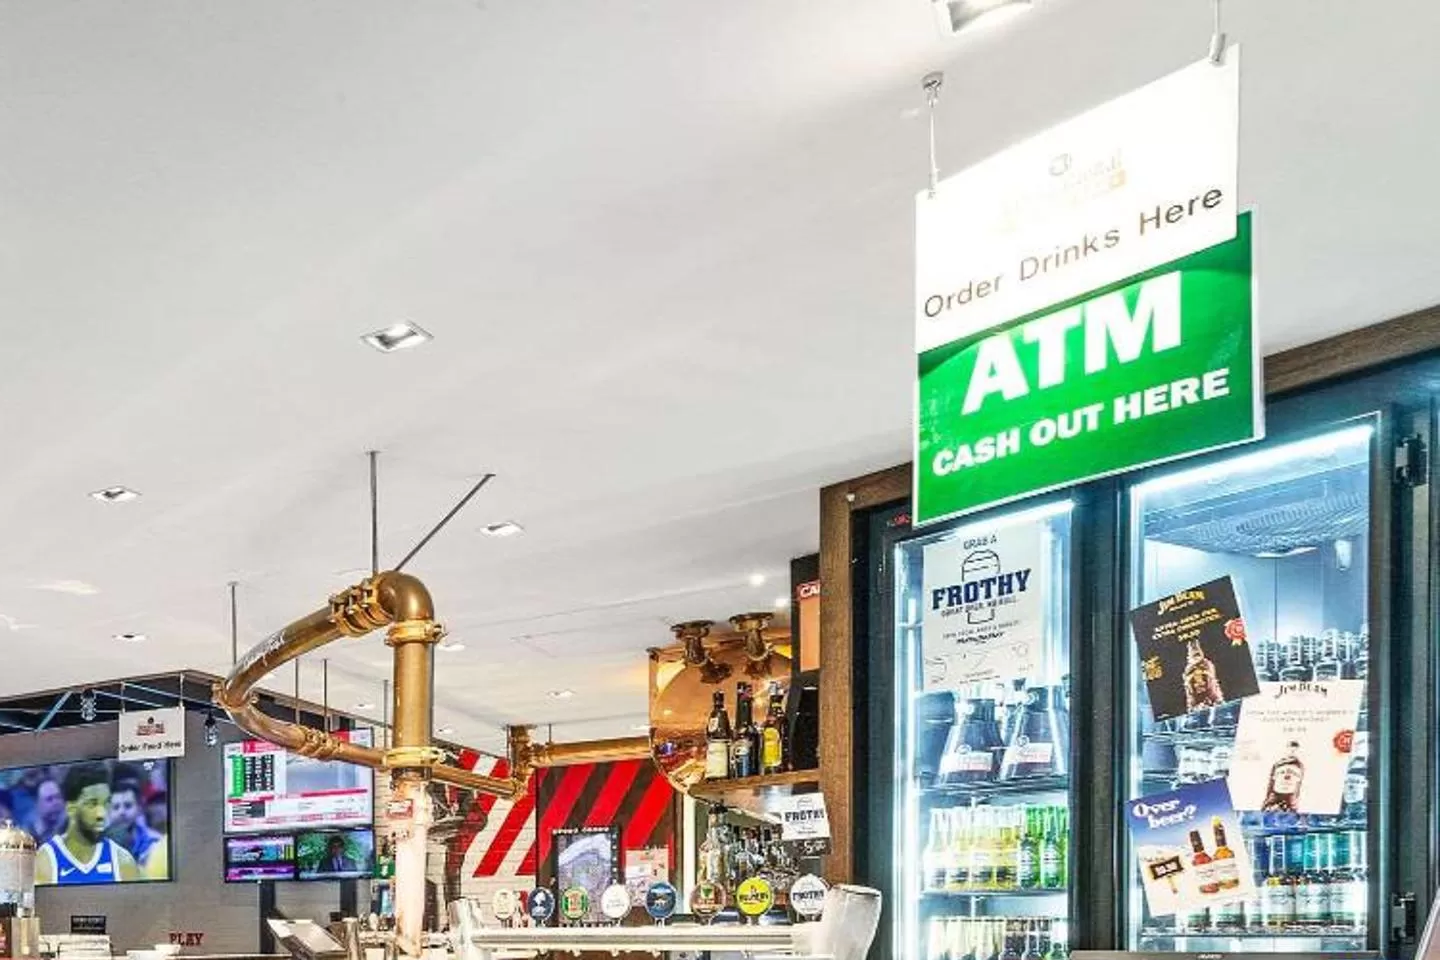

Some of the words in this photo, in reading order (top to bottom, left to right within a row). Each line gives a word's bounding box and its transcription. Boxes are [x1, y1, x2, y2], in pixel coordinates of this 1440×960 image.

[923, 272, 1003, 318] Order
[1018, 228, 1121, 282] Drinks
[1139, 187, 1223, 236] Here
[962, 270, 1182, 416] ATM
[932, 427, 1021, 476] CASH
[1029, 403, 1105, 446] OUT
[1112, 367, 1231, 425] HERE
[931, 568, 1032, 610] FROTHY
[1133, 800, 1180, 817] Over
[1148, 804, 1197, 829] beer?
[169, 933, 204, 946] PLAY
